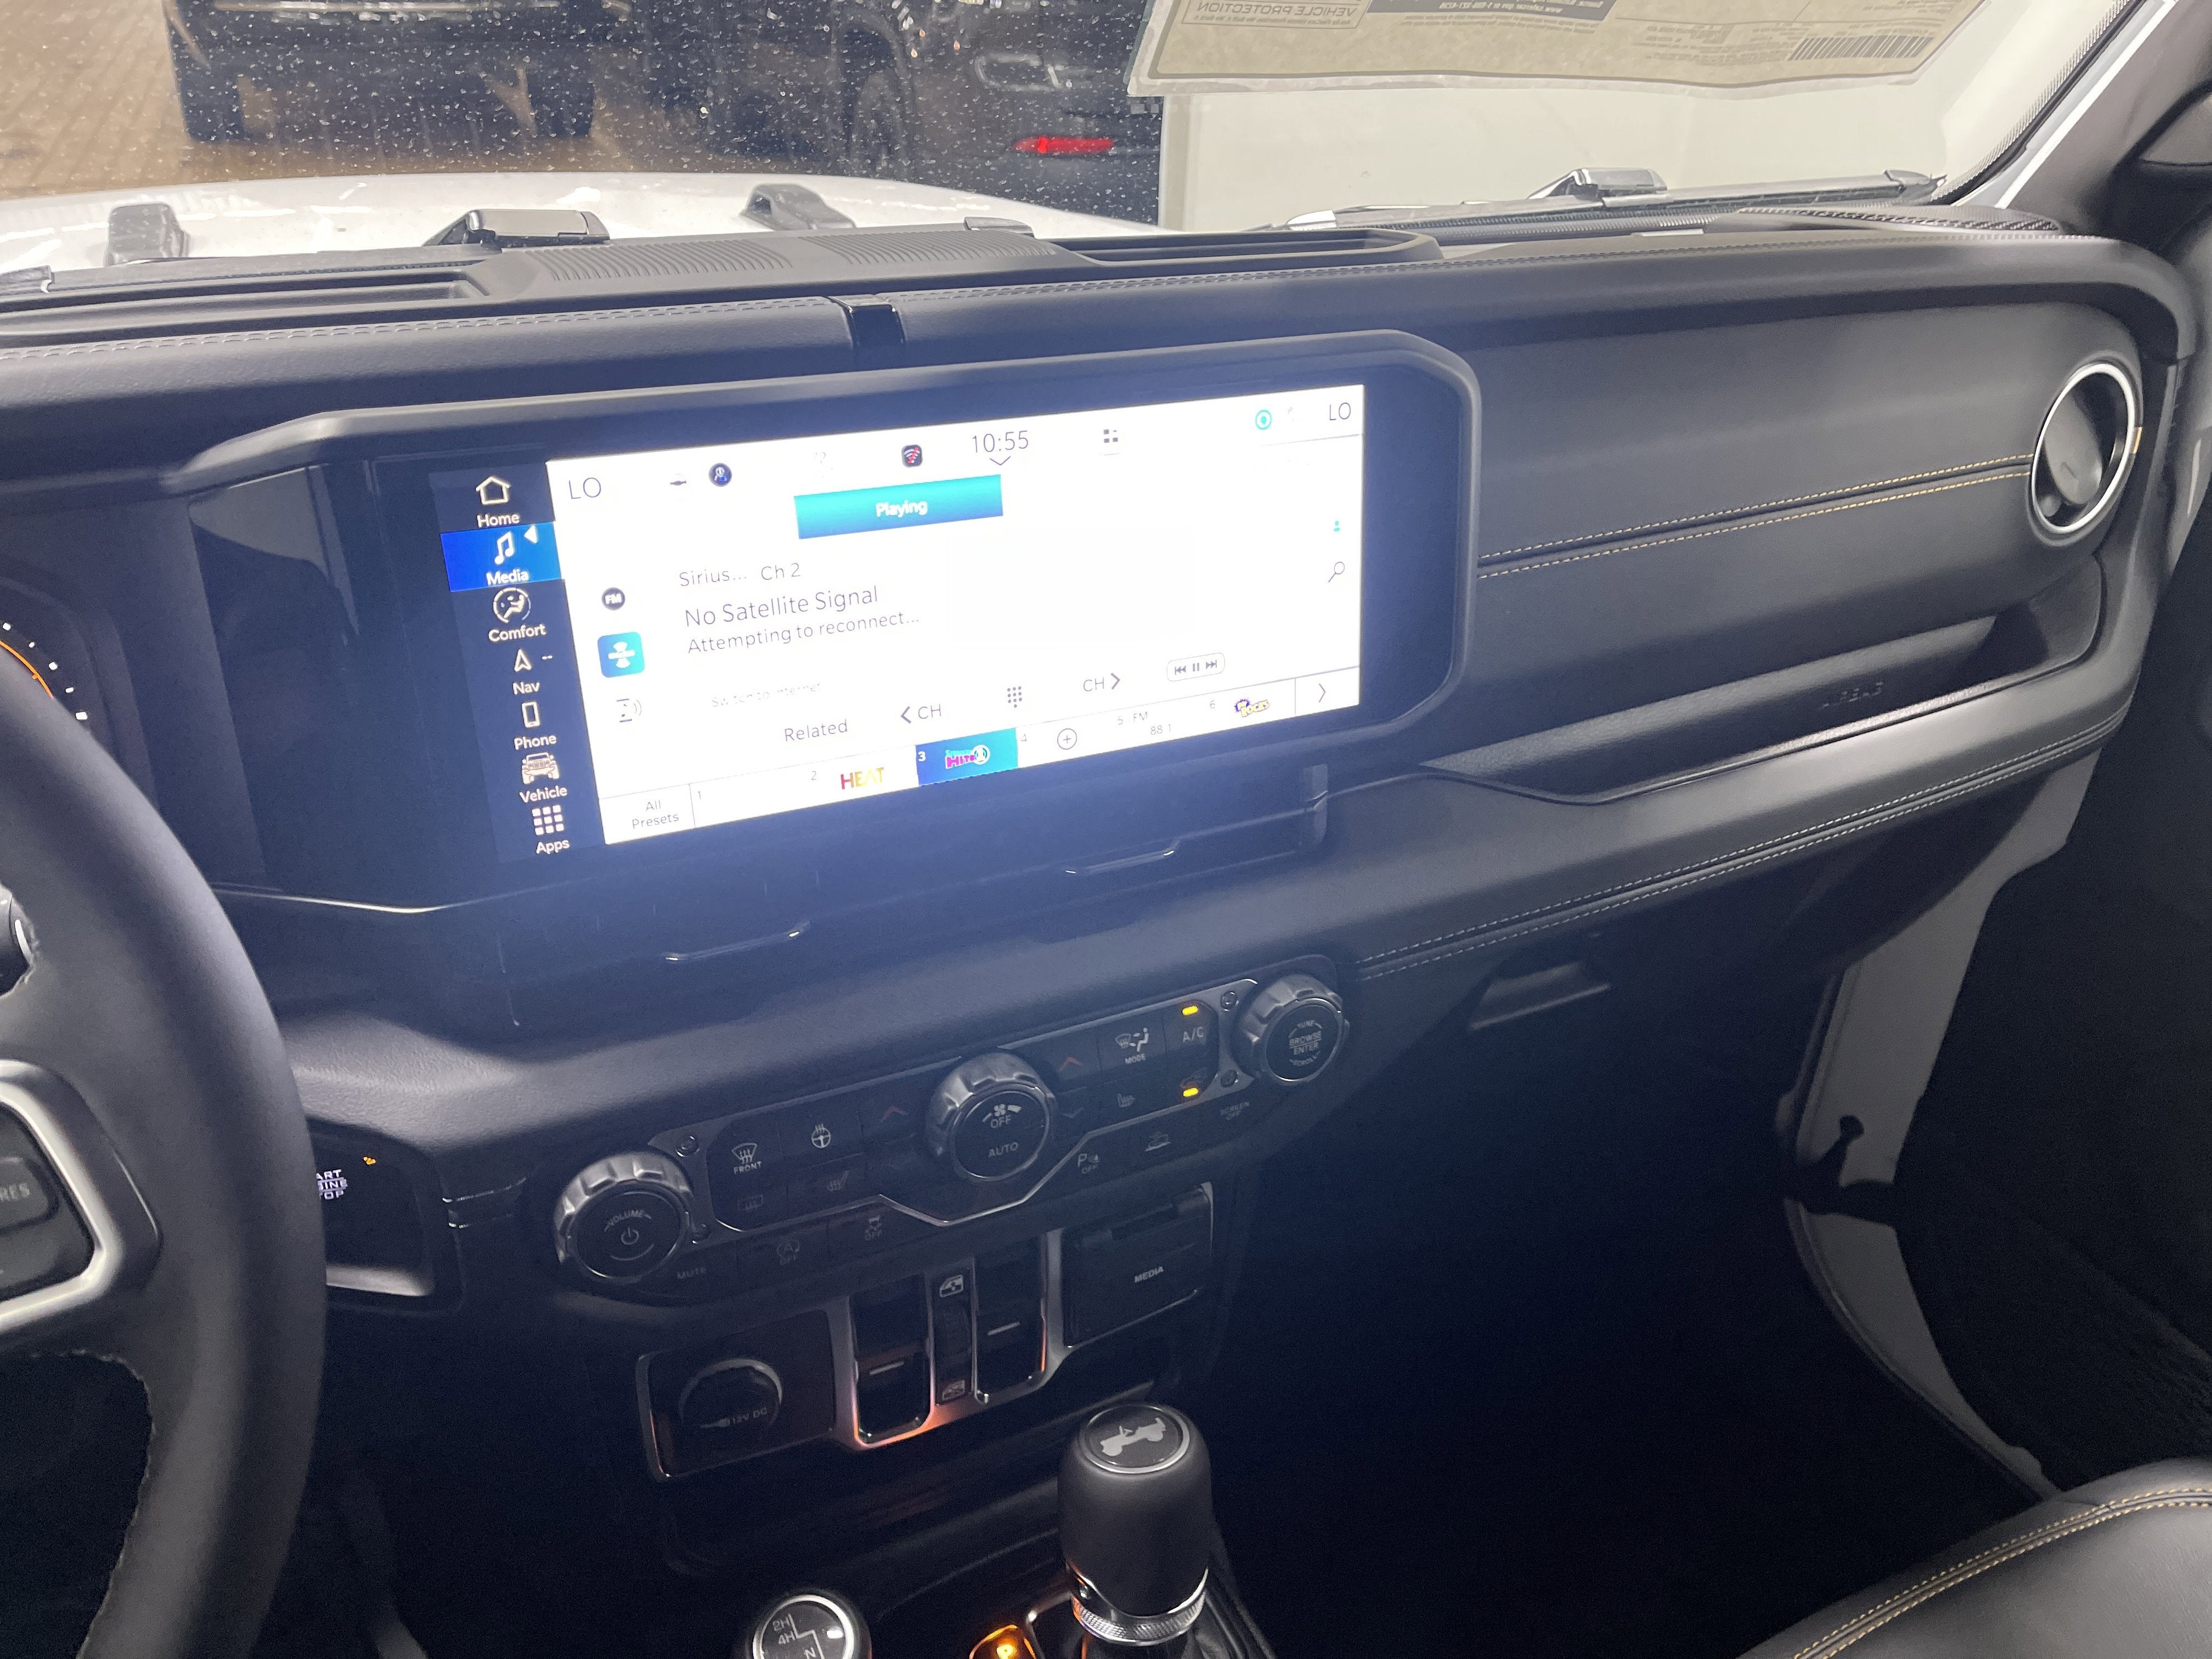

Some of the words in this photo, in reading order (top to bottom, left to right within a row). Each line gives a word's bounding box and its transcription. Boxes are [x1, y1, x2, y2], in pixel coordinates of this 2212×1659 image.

[1329, 402, 1351, 421] LO
[972, 430, 1029, 453] 10:55
[568, 477, 602, 500] LO
[875, 499, 928, 518] Playing
[477, 512, 521, 528] Home
[486, 569, 529, 585] Media
[761, 565, 785, 580] Ch
[790, 562, 801, 577] 2
[685, 608, 715, 627] No
[723, 596, 809, 622] Satellite
[815, 585, 878, 612] Signal
[488, 623, 546, 642] Comfort
[688, 629, 791, 653] Attempting
[796, 625, 813, 638] to
[819, 612, 919, 635] reconnect...
[512, 681, 540, 696] Nav
[1082, 676, 1104, 692] CH
[918, 704, 942, 720] CH
[785, 719, 848, 742] Related
[514, 733, 557, 750] Phone
[918, 751, 926, 762] 3
[810, 770, 817, 781] 2
[840, 767, 884, 789] HEAT
[519, 785, 568, 803] Vehicle
[697, 791, 702, 800] 1
[645, 799, 662, 812] All
[631, 812, 679, 830] Presets
[535, 839, 570, 854] Apps
[1182, 1026, 1204, 1043] A/C
[1289, 1030, 1322, 1046] BROWSE
[1293, 1042, 1319, 1055] ENTER
[1125, 1052, 1146, 1064] MODE
[990, 1114, 1012, 1129] OFF
[988, 1141, 1019, 1158] AUTO
[317, 1169, 342, 1180] ART
[733, 1161, 762, 1174] FRONT
[607, 1209, 645, 1227] VOLUME
[1134, 1266, 1164, 1283] MEDIA
[772, 1616, 790, 1632] 2H
[778, 1630, 795, 1646] 4H
[804, 1646, 817, 1659] N
